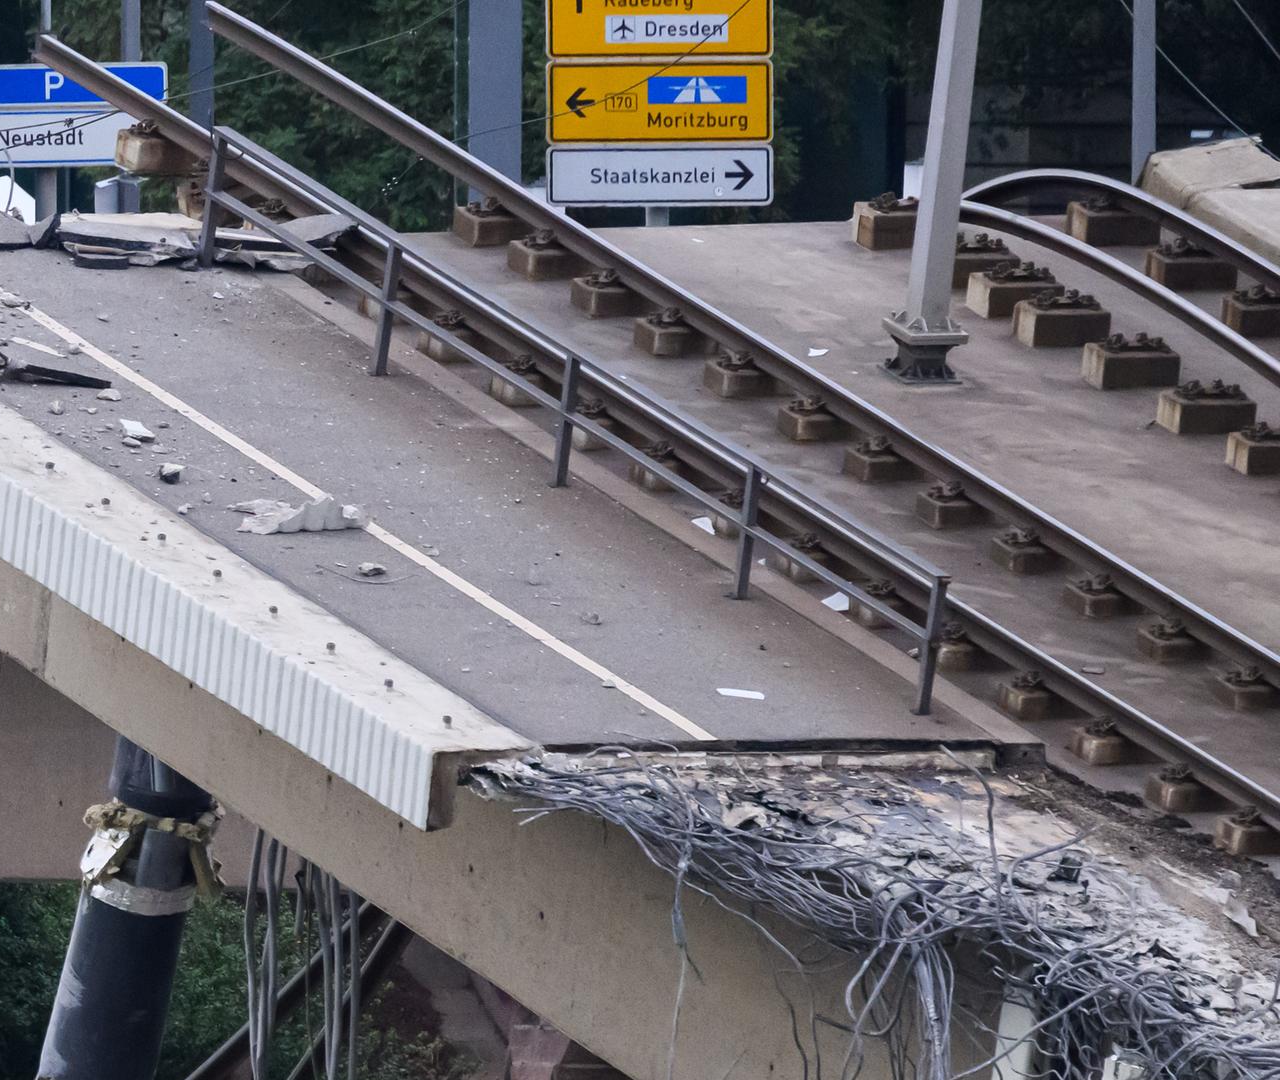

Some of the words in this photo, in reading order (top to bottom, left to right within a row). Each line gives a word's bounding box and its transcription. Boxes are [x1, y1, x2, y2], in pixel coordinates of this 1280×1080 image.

[644, 20, 723, 37] Dresden
[44, 71, 65, 100] P
[610, 96, 632, 109] 170
[647, 111, 748, 131] Moritzburg
[590, 167, 716, 184] Staatskanzlei
